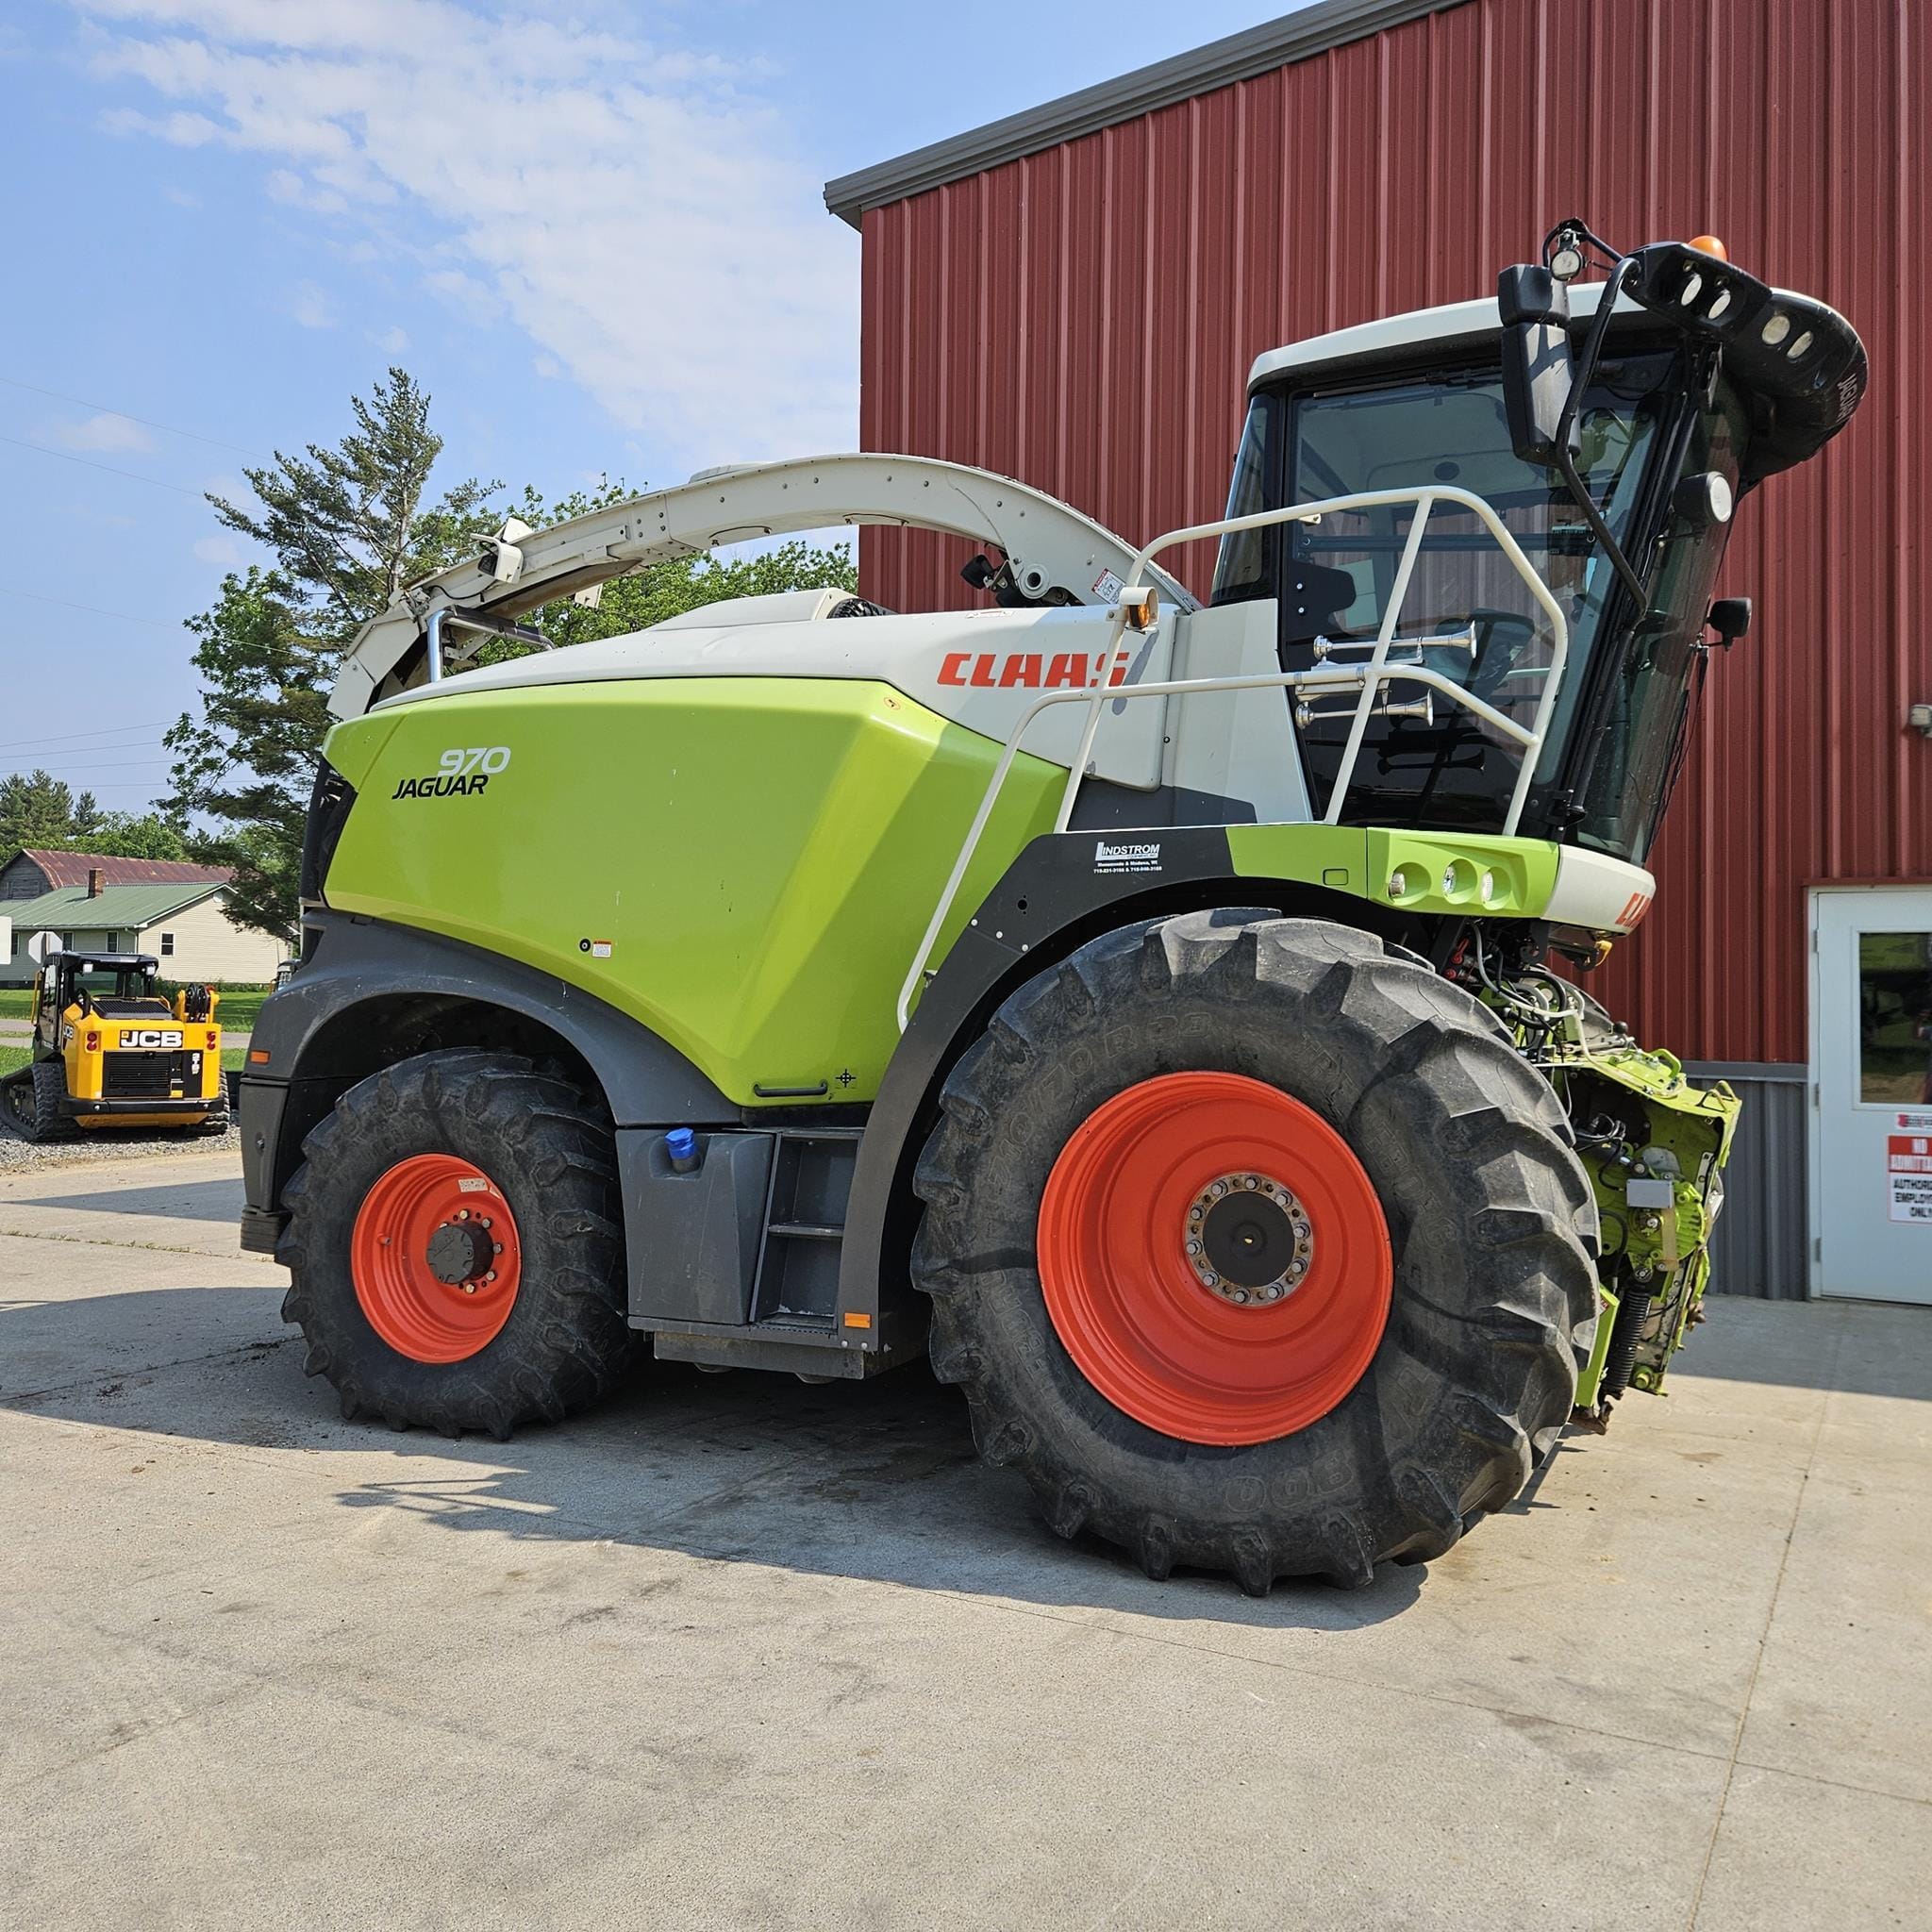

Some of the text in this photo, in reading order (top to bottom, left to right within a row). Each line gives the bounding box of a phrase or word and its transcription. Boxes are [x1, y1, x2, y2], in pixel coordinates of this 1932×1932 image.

[937, 652, 1130, 688] CLAAS
[437, 746, 511, 777] 970
[391, 774, 489, 800] JAGUAR
[1095, 841, 1161, 861] LINDSTROM
[120, 1030, 183, 1049] JCB
